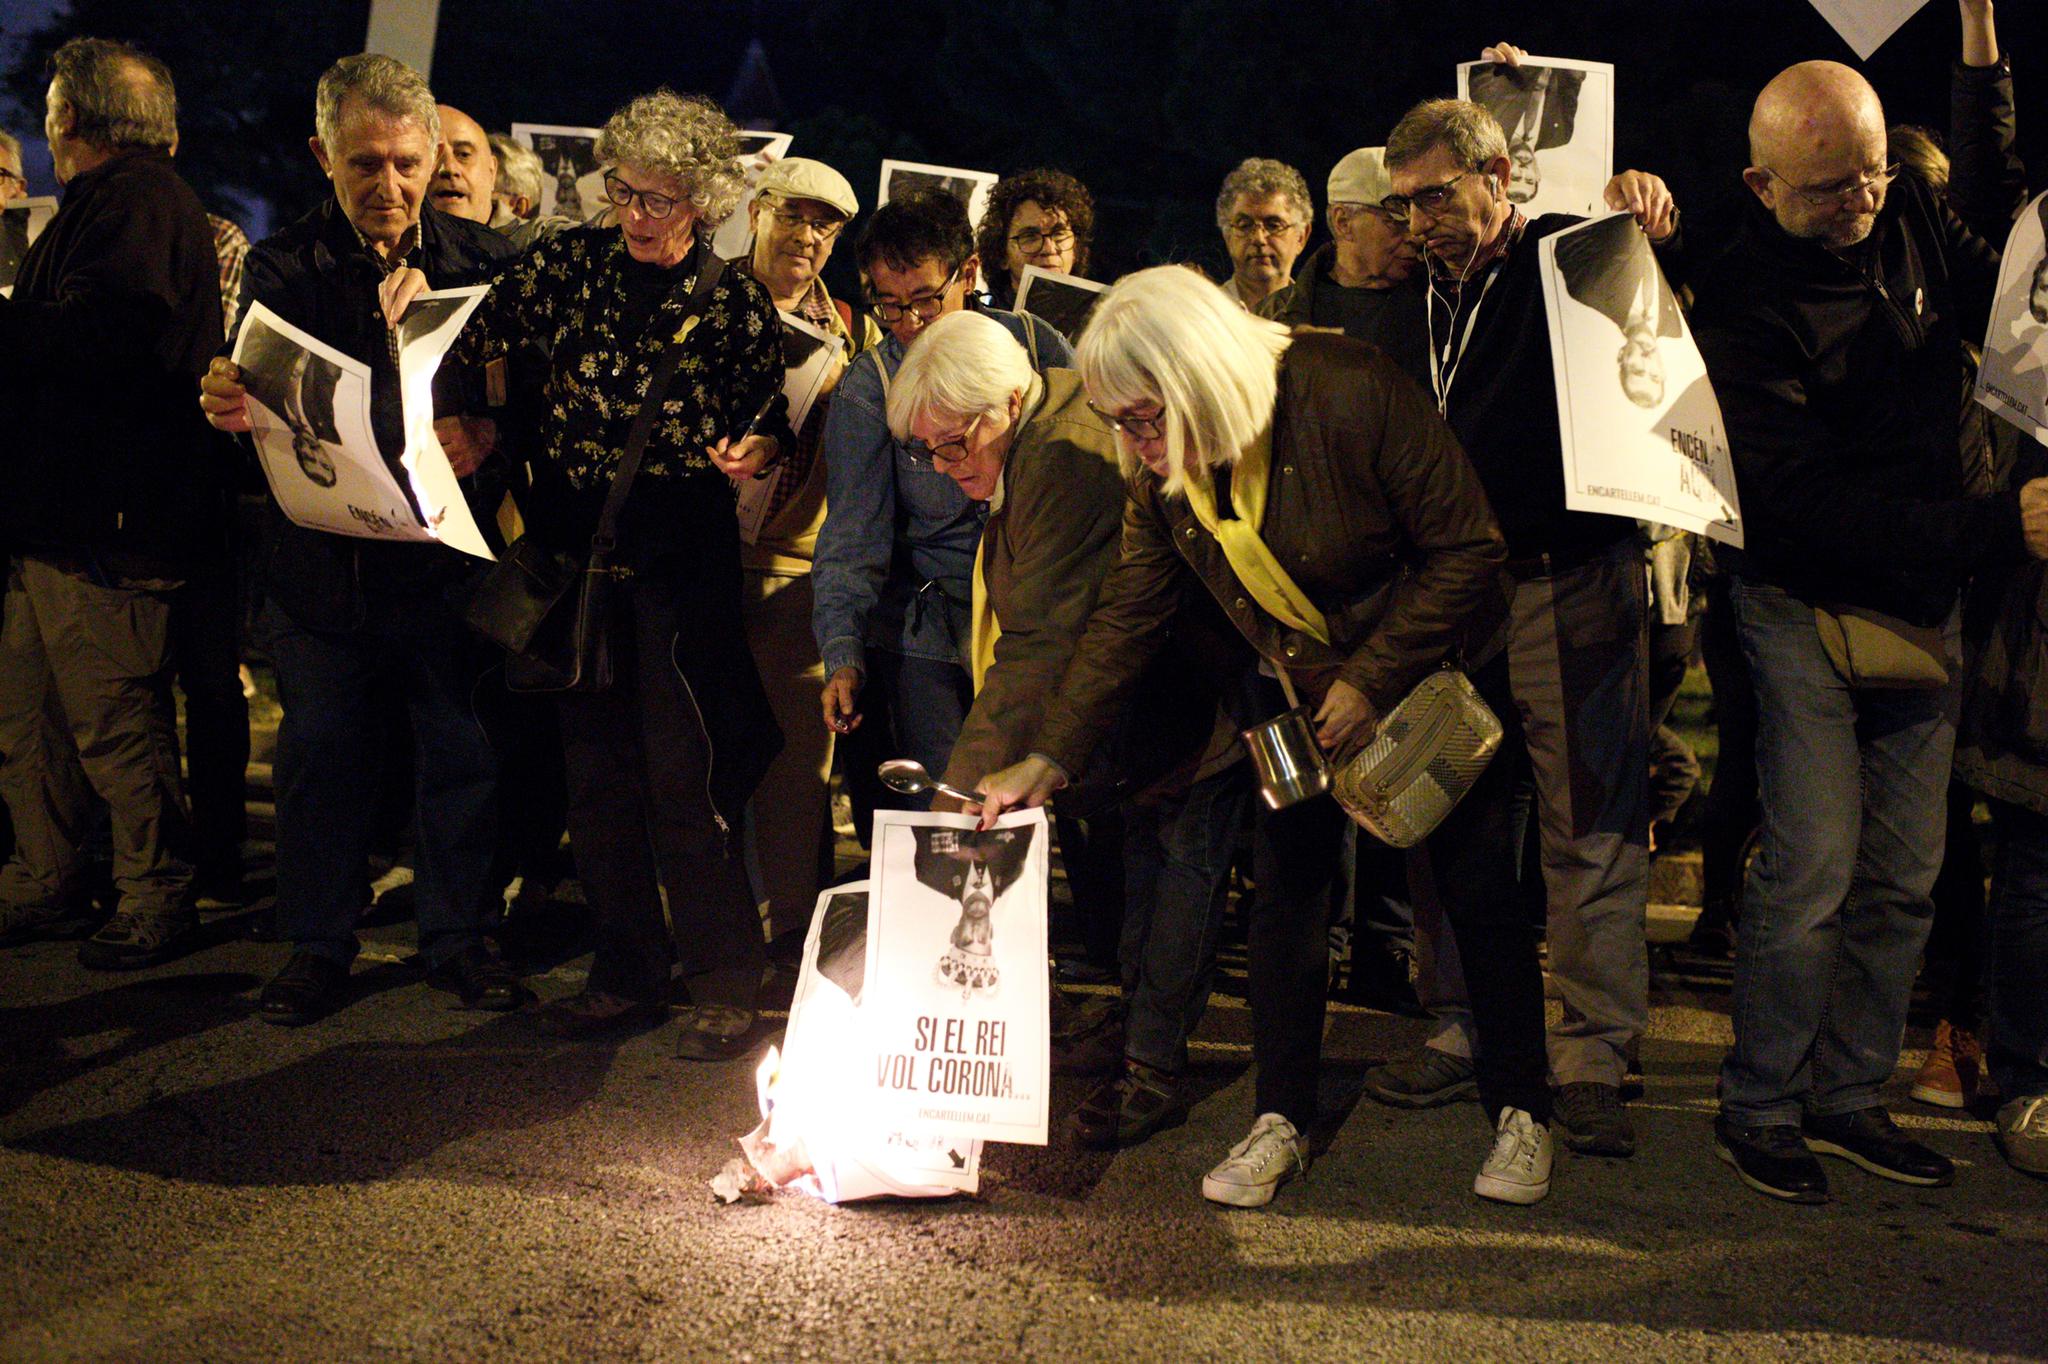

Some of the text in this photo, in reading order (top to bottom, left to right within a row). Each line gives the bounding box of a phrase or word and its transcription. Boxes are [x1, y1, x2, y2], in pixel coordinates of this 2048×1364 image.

[1671, 428, 1708, 465] ENCÉN
[1587, 484, 1661, 506] ENCARTELLEM.CAT
[914, 1016, 1006, 1057] SI EL REI
[877, 1054, 1030, 1100] VOL CORONA...
